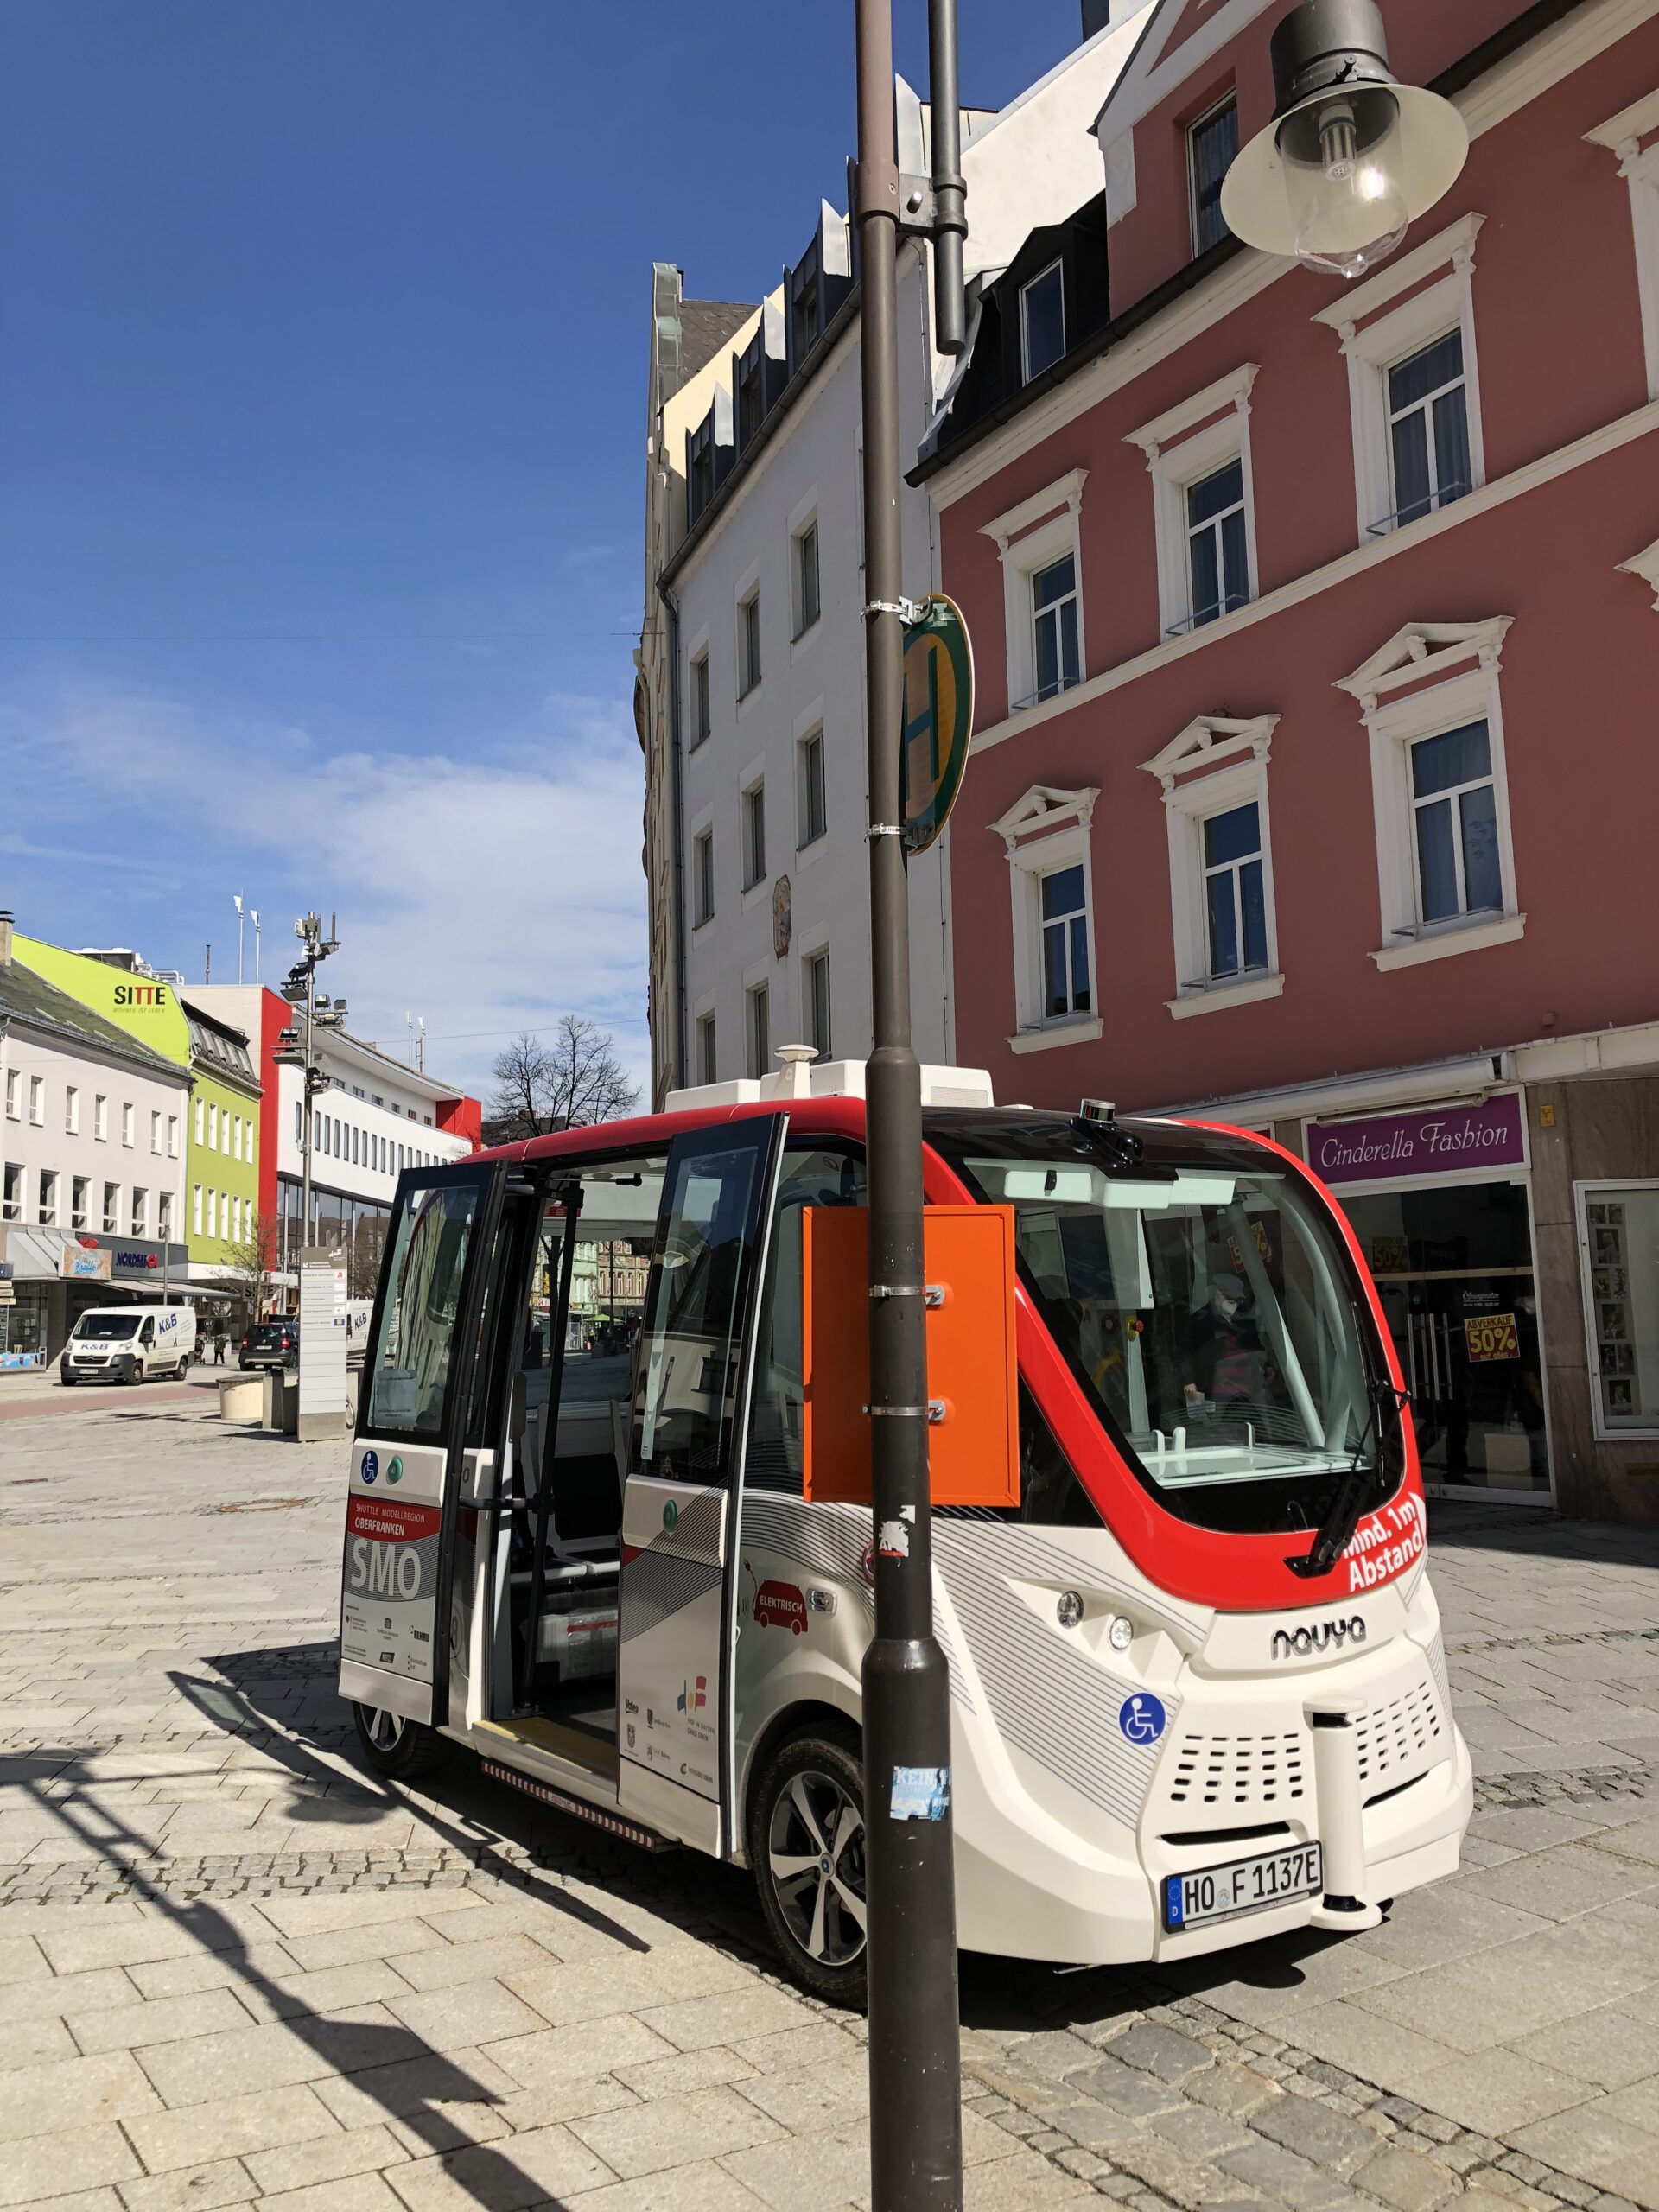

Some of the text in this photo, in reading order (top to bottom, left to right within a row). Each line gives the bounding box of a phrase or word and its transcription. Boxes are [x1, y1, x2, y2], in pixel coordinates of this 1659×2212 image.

[113, 985, 166, 1005] SITTE
[1321, 1120, 1508, 1168] Cinderella Fashion
[157, 1313, 178, 1335] K&B
[353, 1312, 367, 1330] K&B
[1467, 1315, 1512, 1330] ABVERKAUF
[1470, 1326, 1516, 1354] 50%
[355, 1503, 425, 1523] SHUTTLE MODELLREGION
[354, 1516, 405, 1536] OBERFRANKEN
[1341, 1514, 1393, 1560] Mind.
[1349, 1520, 1423, 1593] Abstand
[350, 1537, 422, 1601] SMO
[760, 1595, 803, 1614] ELEKTRISCH
[1185, 1875, 1215, 1916] HO
[1232, 1868, 1246, 1904] F
[1252, 1849, 1319, 1899] 1137E
[1172, 1906, 1179, 1916] D
